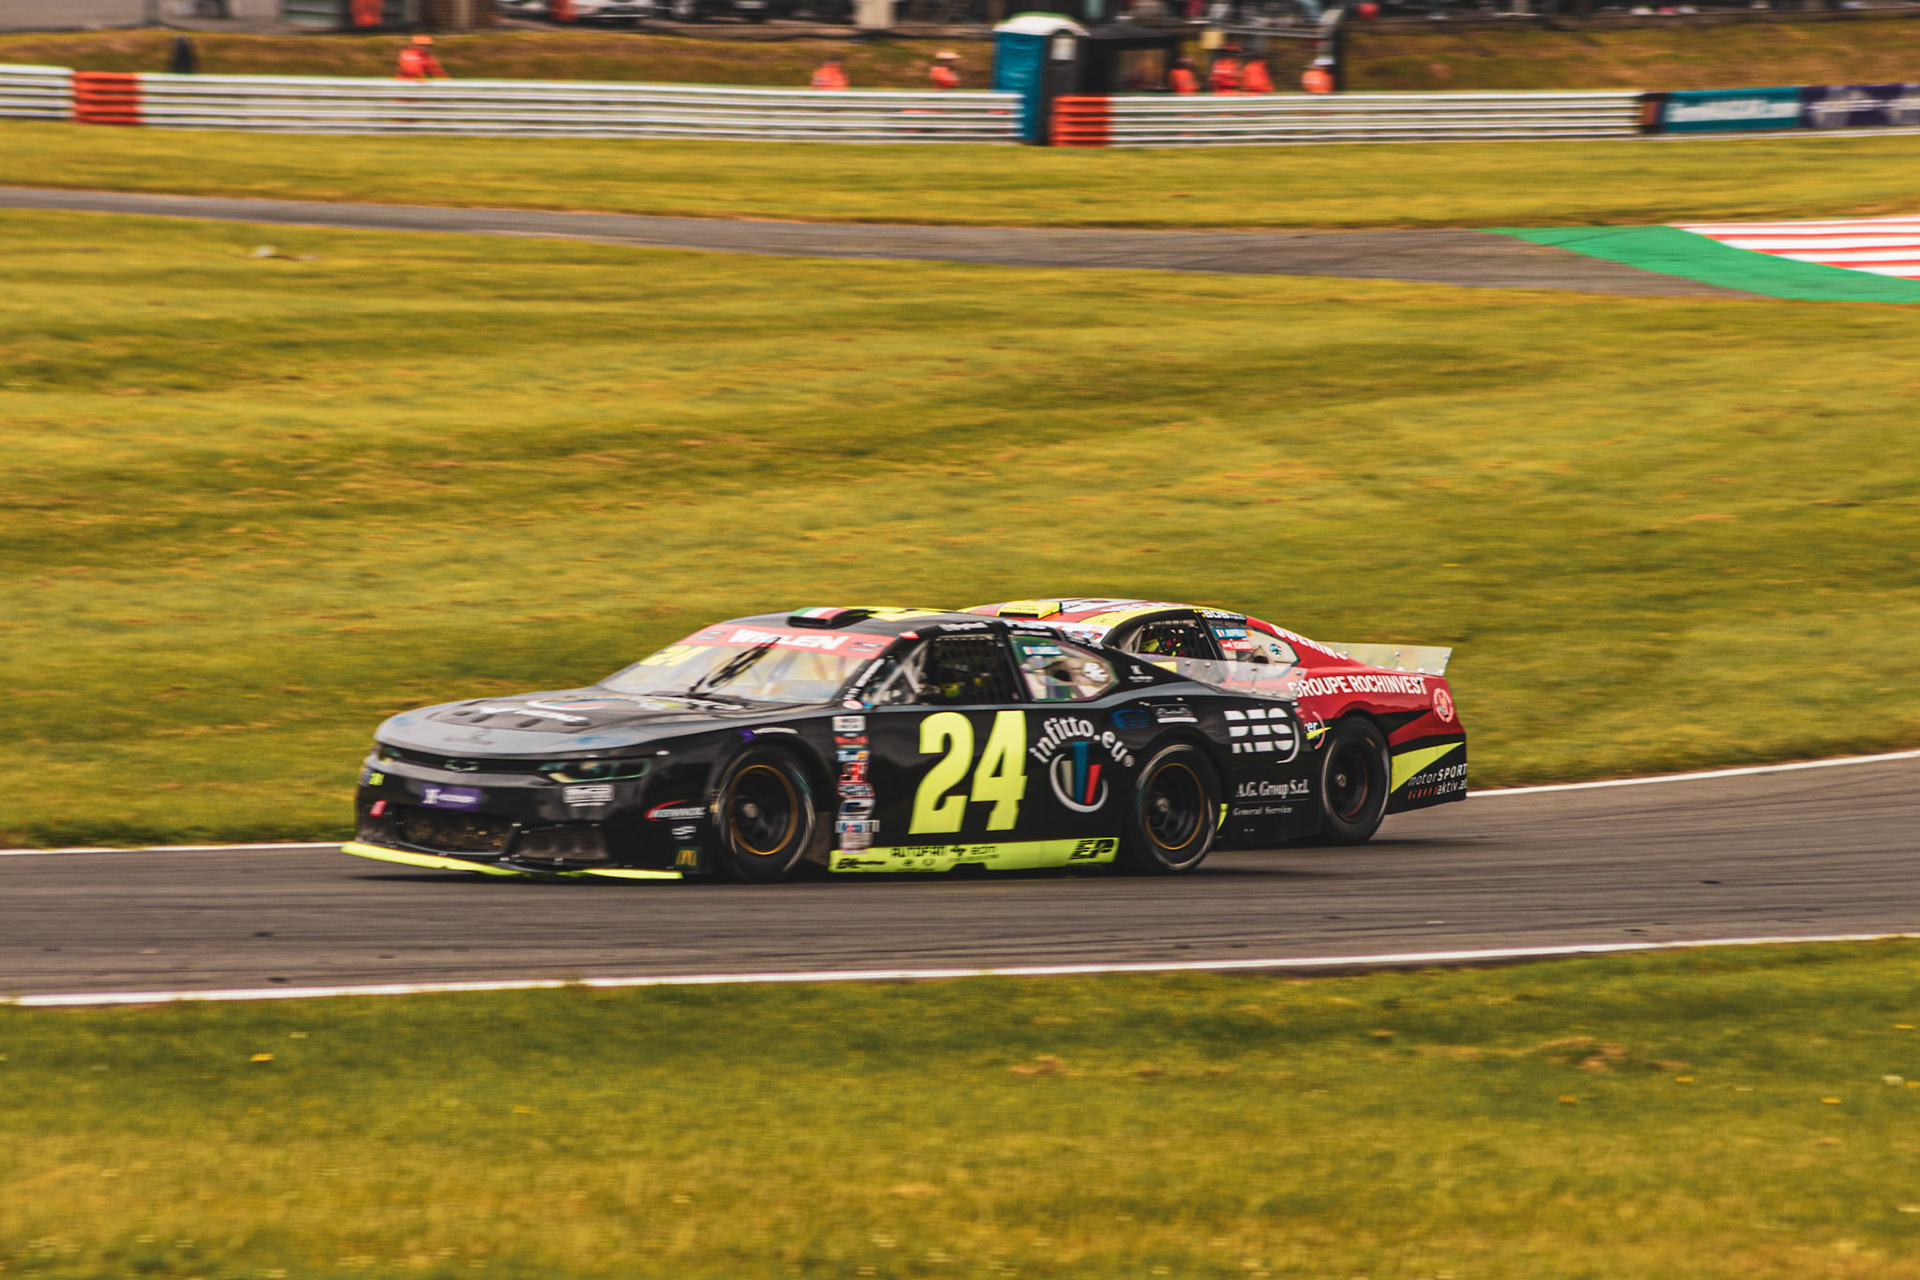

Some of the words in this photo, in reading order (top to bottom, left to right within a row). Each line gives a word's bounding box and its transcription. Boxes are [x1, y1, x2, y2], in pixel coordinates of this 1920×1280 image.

[1287, 675, 1352, 698] GROUPE
[1346, 674, 1427, 695] ROCHINVEST
[908, 710, 1028, 835] 24
